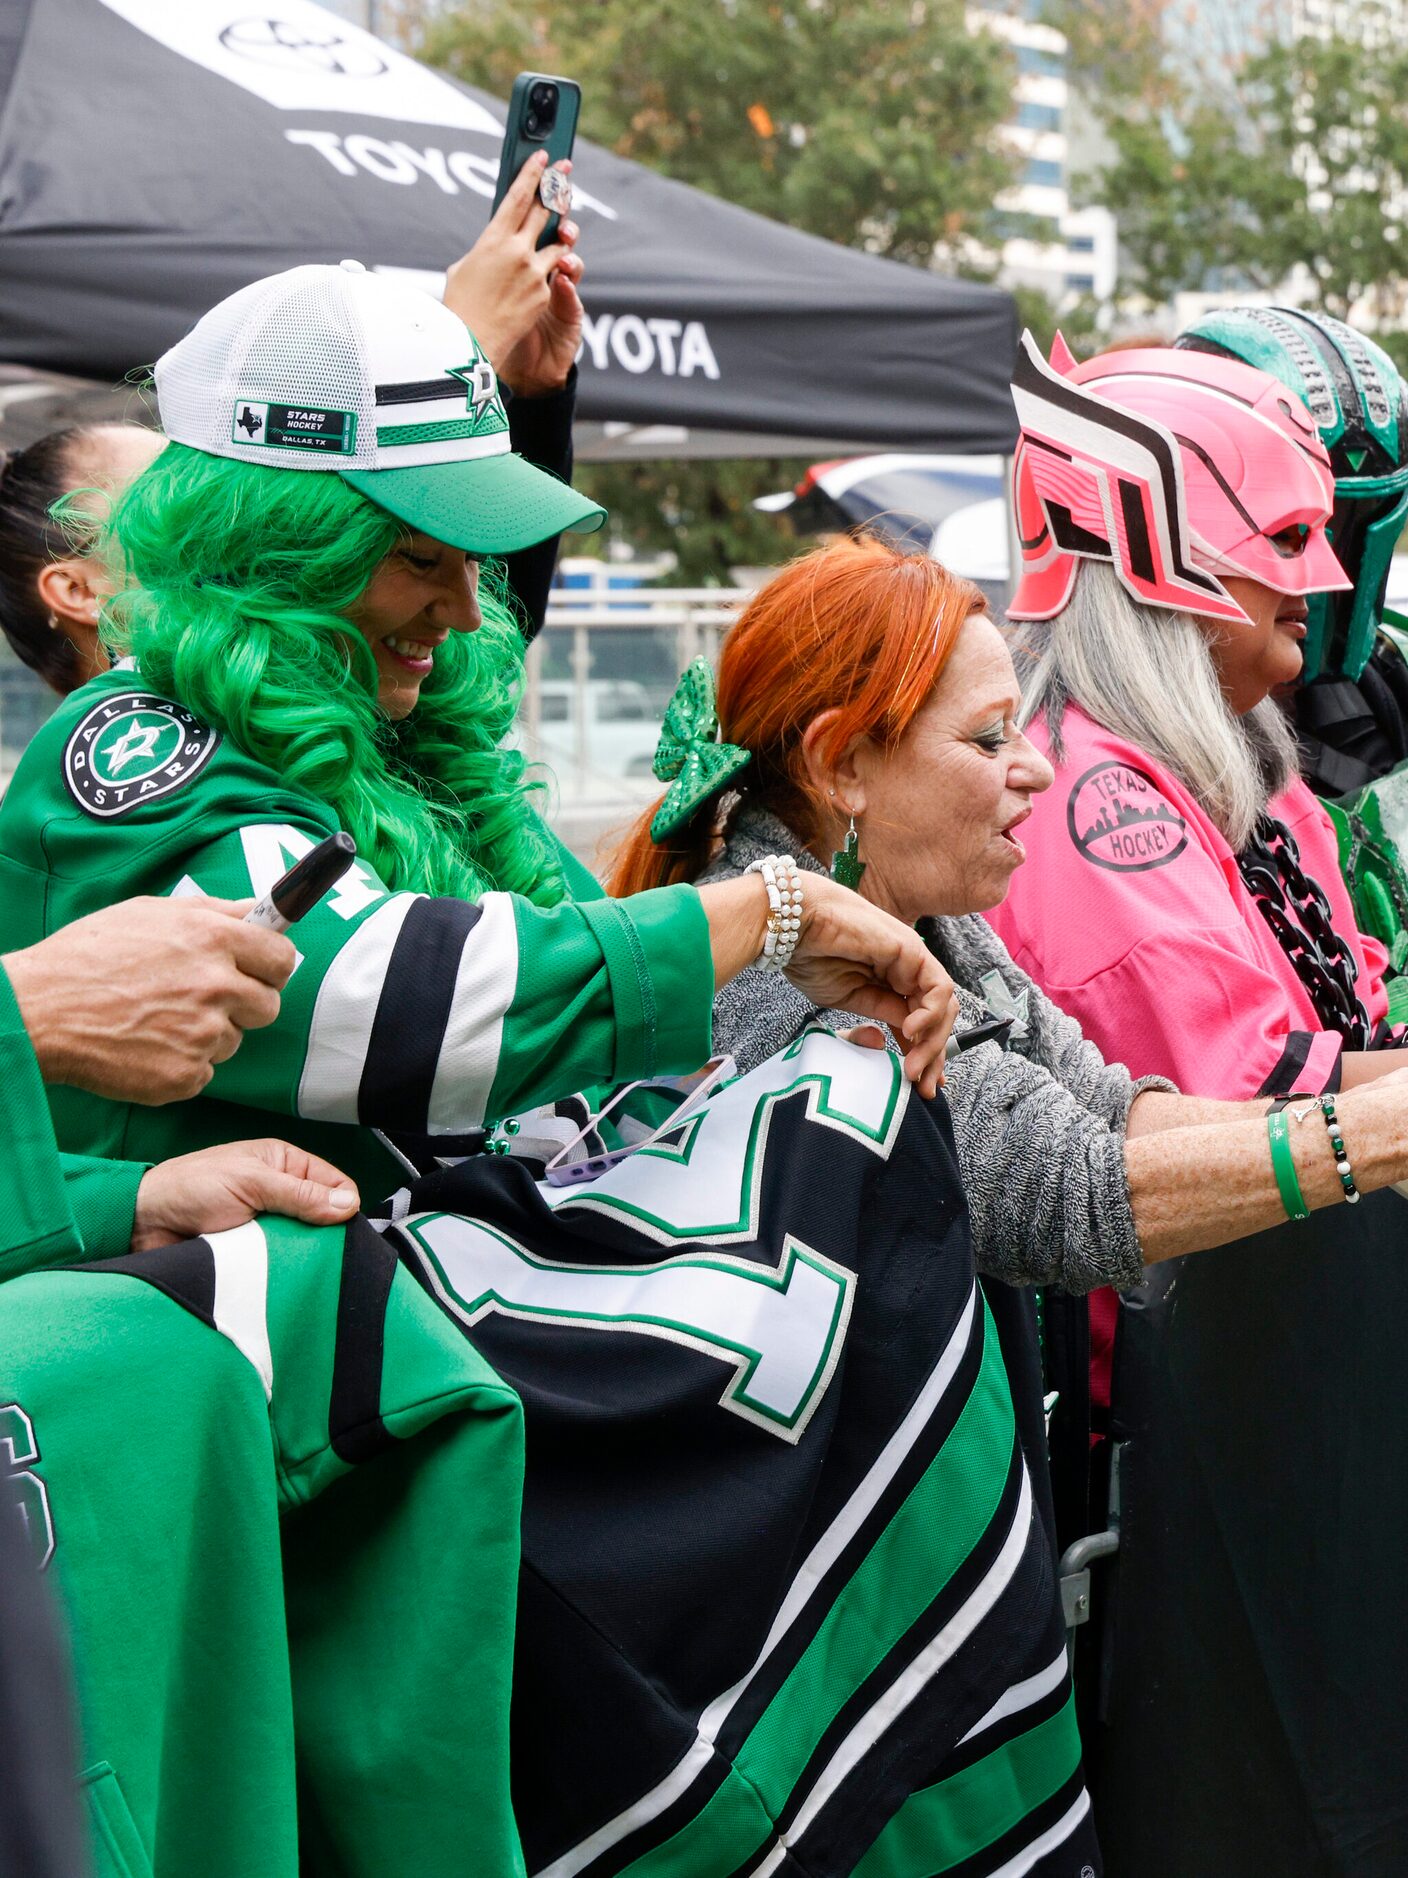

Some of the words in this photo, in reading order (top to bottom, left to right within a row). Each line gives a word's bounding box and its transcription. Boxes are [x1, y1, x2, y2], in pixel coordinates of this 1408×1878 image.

[285, 128, 619, 221] TOYO
[574, 312, 721, 380] YOTA
[286, 410, 326, 423] STARS
[287, 420, 323, 431] HOCKEY
[315, 439, 327, 447] TX
[74, 699, 193, 771] DALLAS
[94, 742, 201, 805] STARS
[1090, 770, 1147, 801] TEXAS
[1109, 822, 1170, 859] HOCKEY
